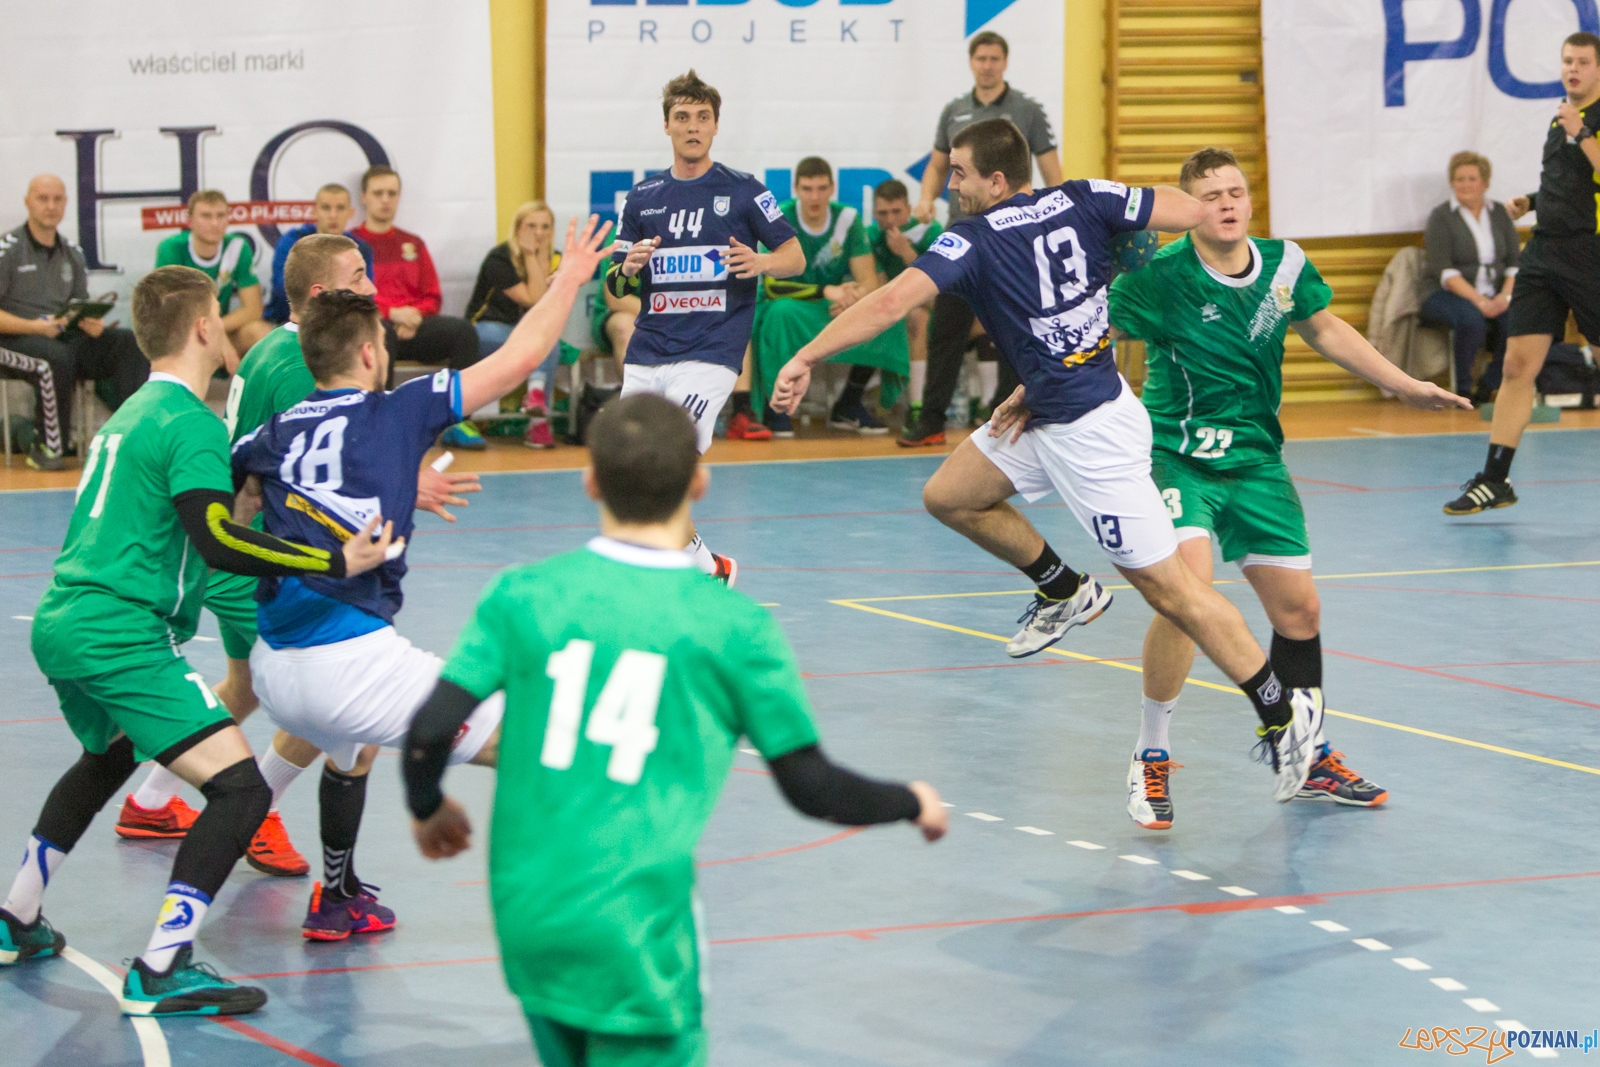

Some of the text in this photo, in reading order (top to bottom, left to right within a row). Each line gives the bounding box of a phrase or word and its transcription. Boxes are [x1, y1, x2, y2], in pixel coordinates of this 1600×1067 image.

[588, 19, 904, 43] PROJEKT
[128, 49, 304, 75] właściciel marki
[251, 204, 314, 221] PIJESZ
[668, 207, 704, 240] 44
[652, 254, 702, 276] ELBUD
[1033, 226, 1088, 310] 13
[669, 296, 722, 309] VEOLIA
[279, 416, 349, 491] 18
[1190, 426, 1233, 459] 23
[1092, 514, 1123, 549] 13
[540, 637, 669, 787] 14
